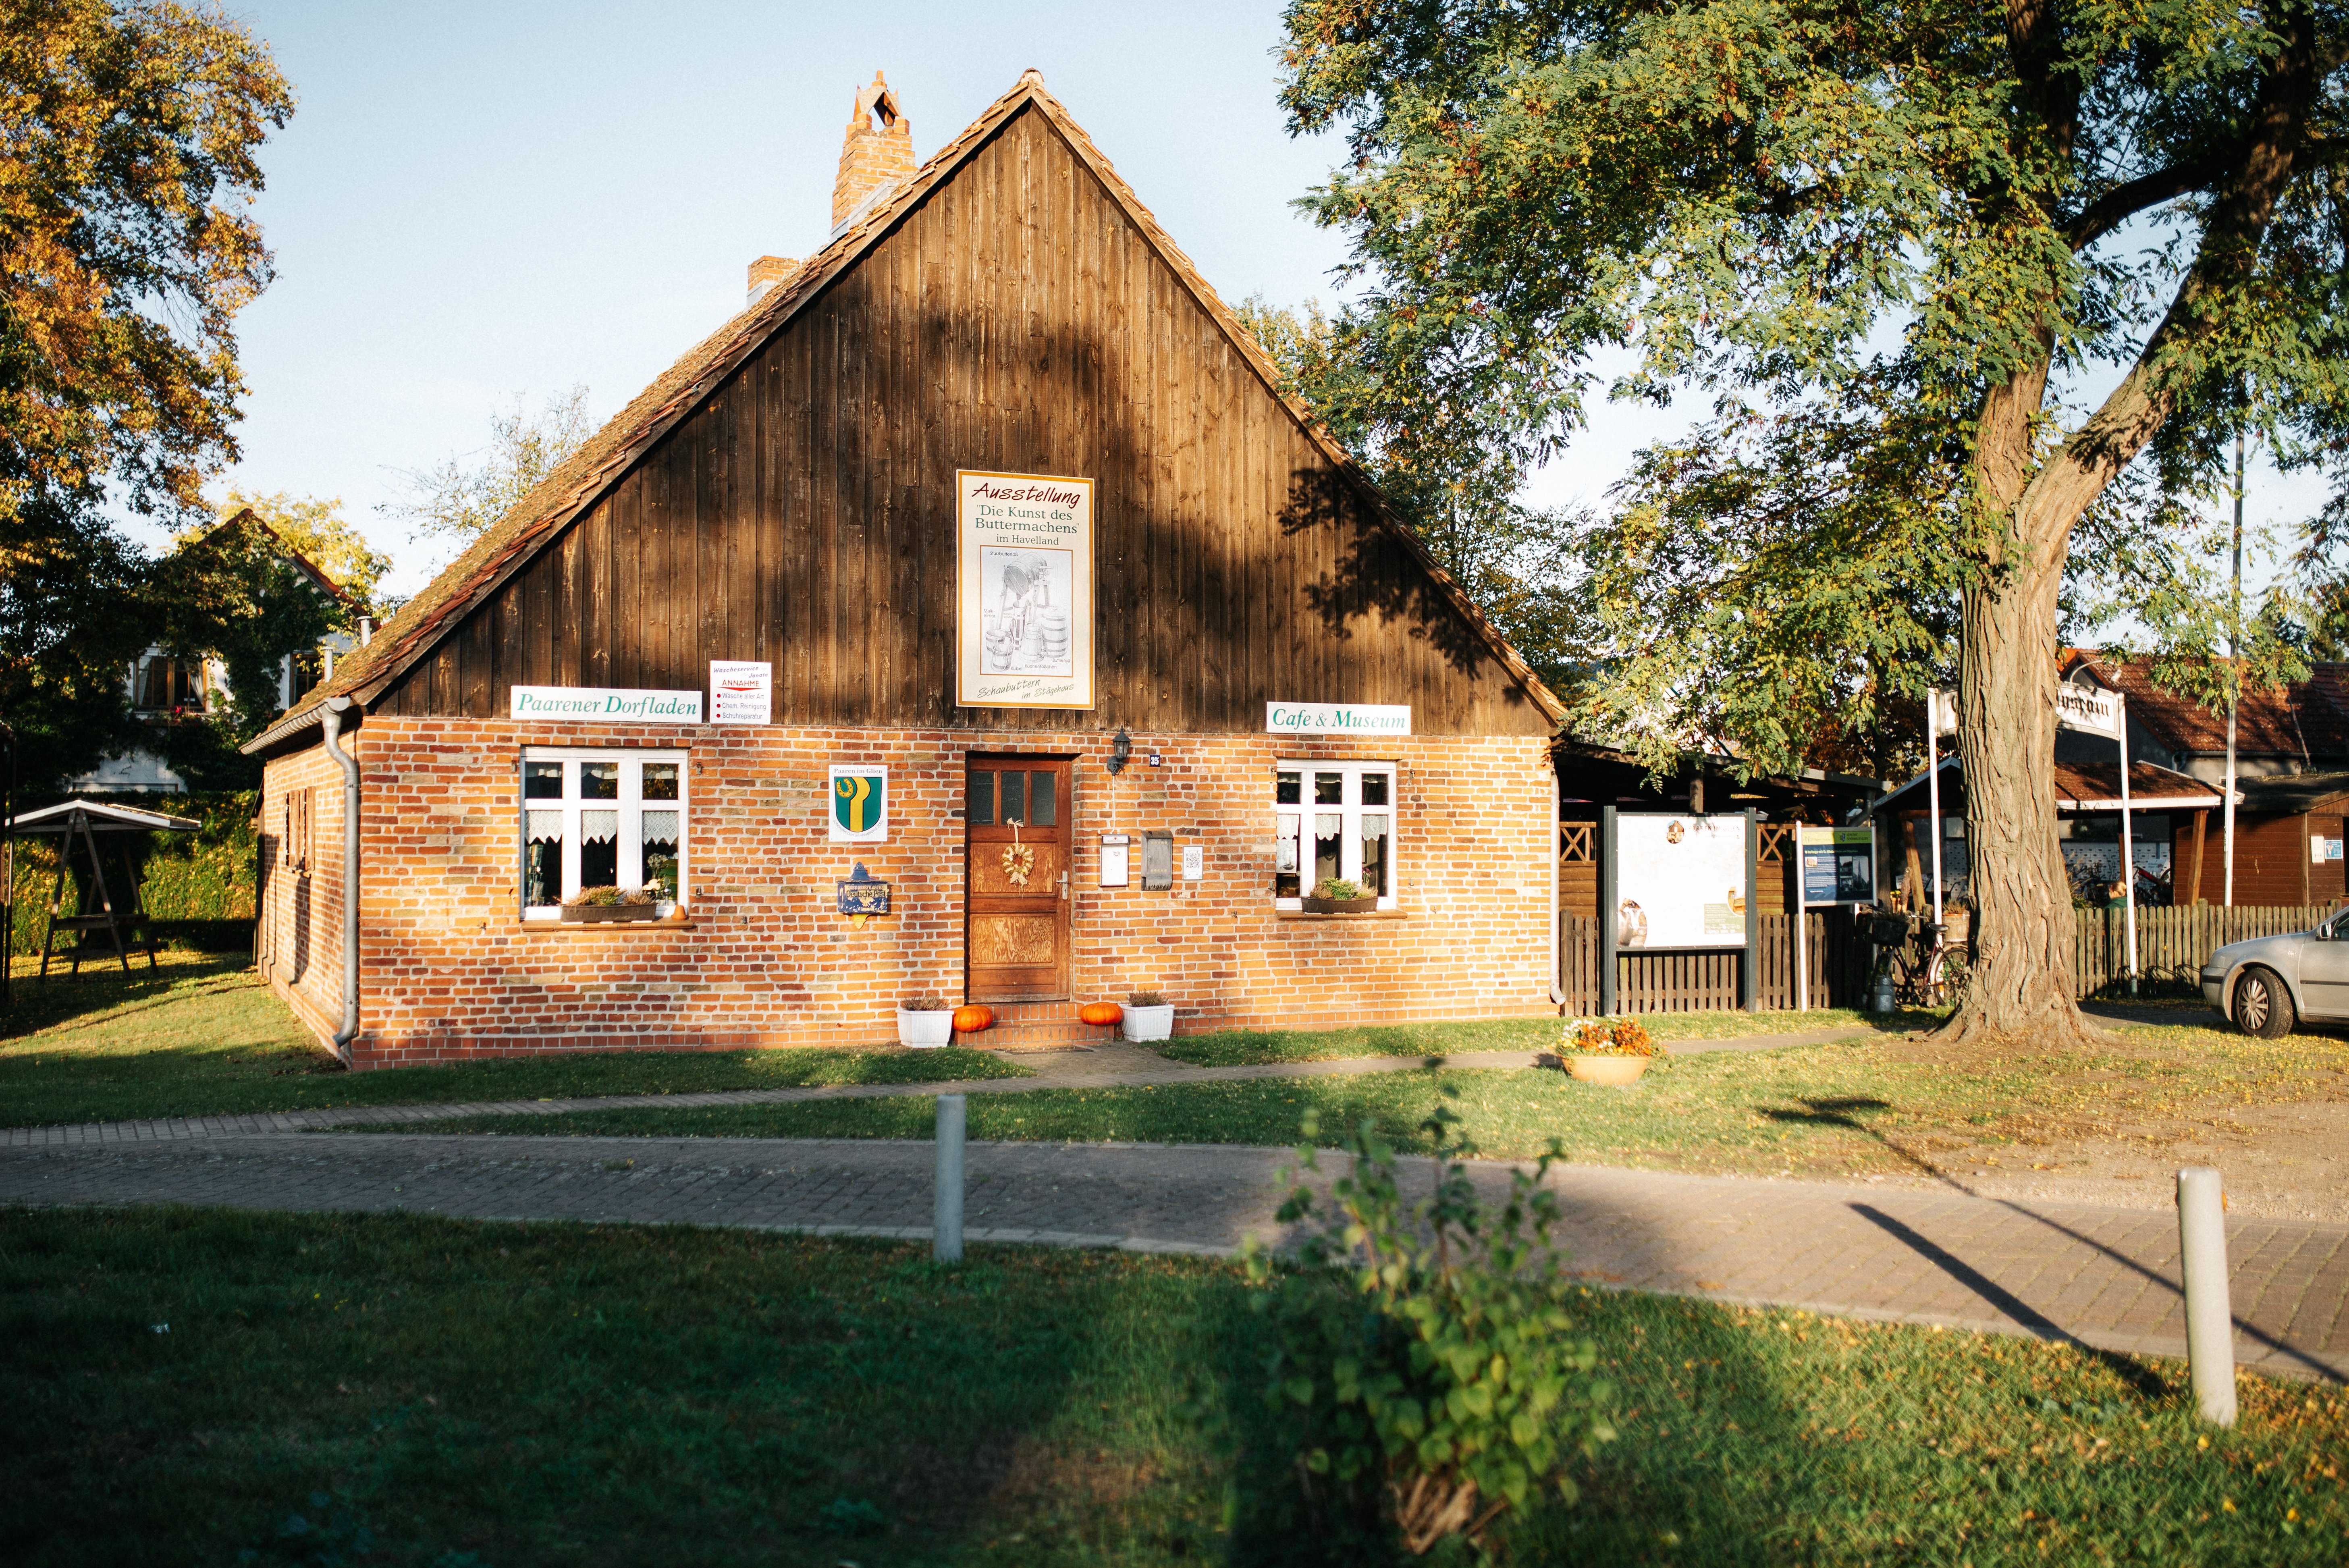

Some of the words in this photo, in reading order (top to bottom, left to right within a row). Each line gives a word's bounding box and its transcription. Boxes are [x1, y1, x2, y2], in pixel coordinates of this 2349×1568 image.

[971, 482, 1080, 509] Ausstellung
[977, 504, 1003, 516] "Die
[1008, 507, 1046, 519] Kunst
[1050, 509, 1072, 520] des
[975, 517, 1080, 533] Buttermachens"
[996, 534, 1008, 542] im
[1012, 535, 1059, 545] Havelland
[977, 679, 1040, 698] Schaubuttern
[517, 694, 601, 712] Paarener
[604, 696, 697, 717] Dorfladen
[1273, 708, 1311, 730] Cafe
[1315, 713, 1327, 727] &
[1331, 710, 1406, 728] Museum
[1151, 756, 1159, 765] 35
